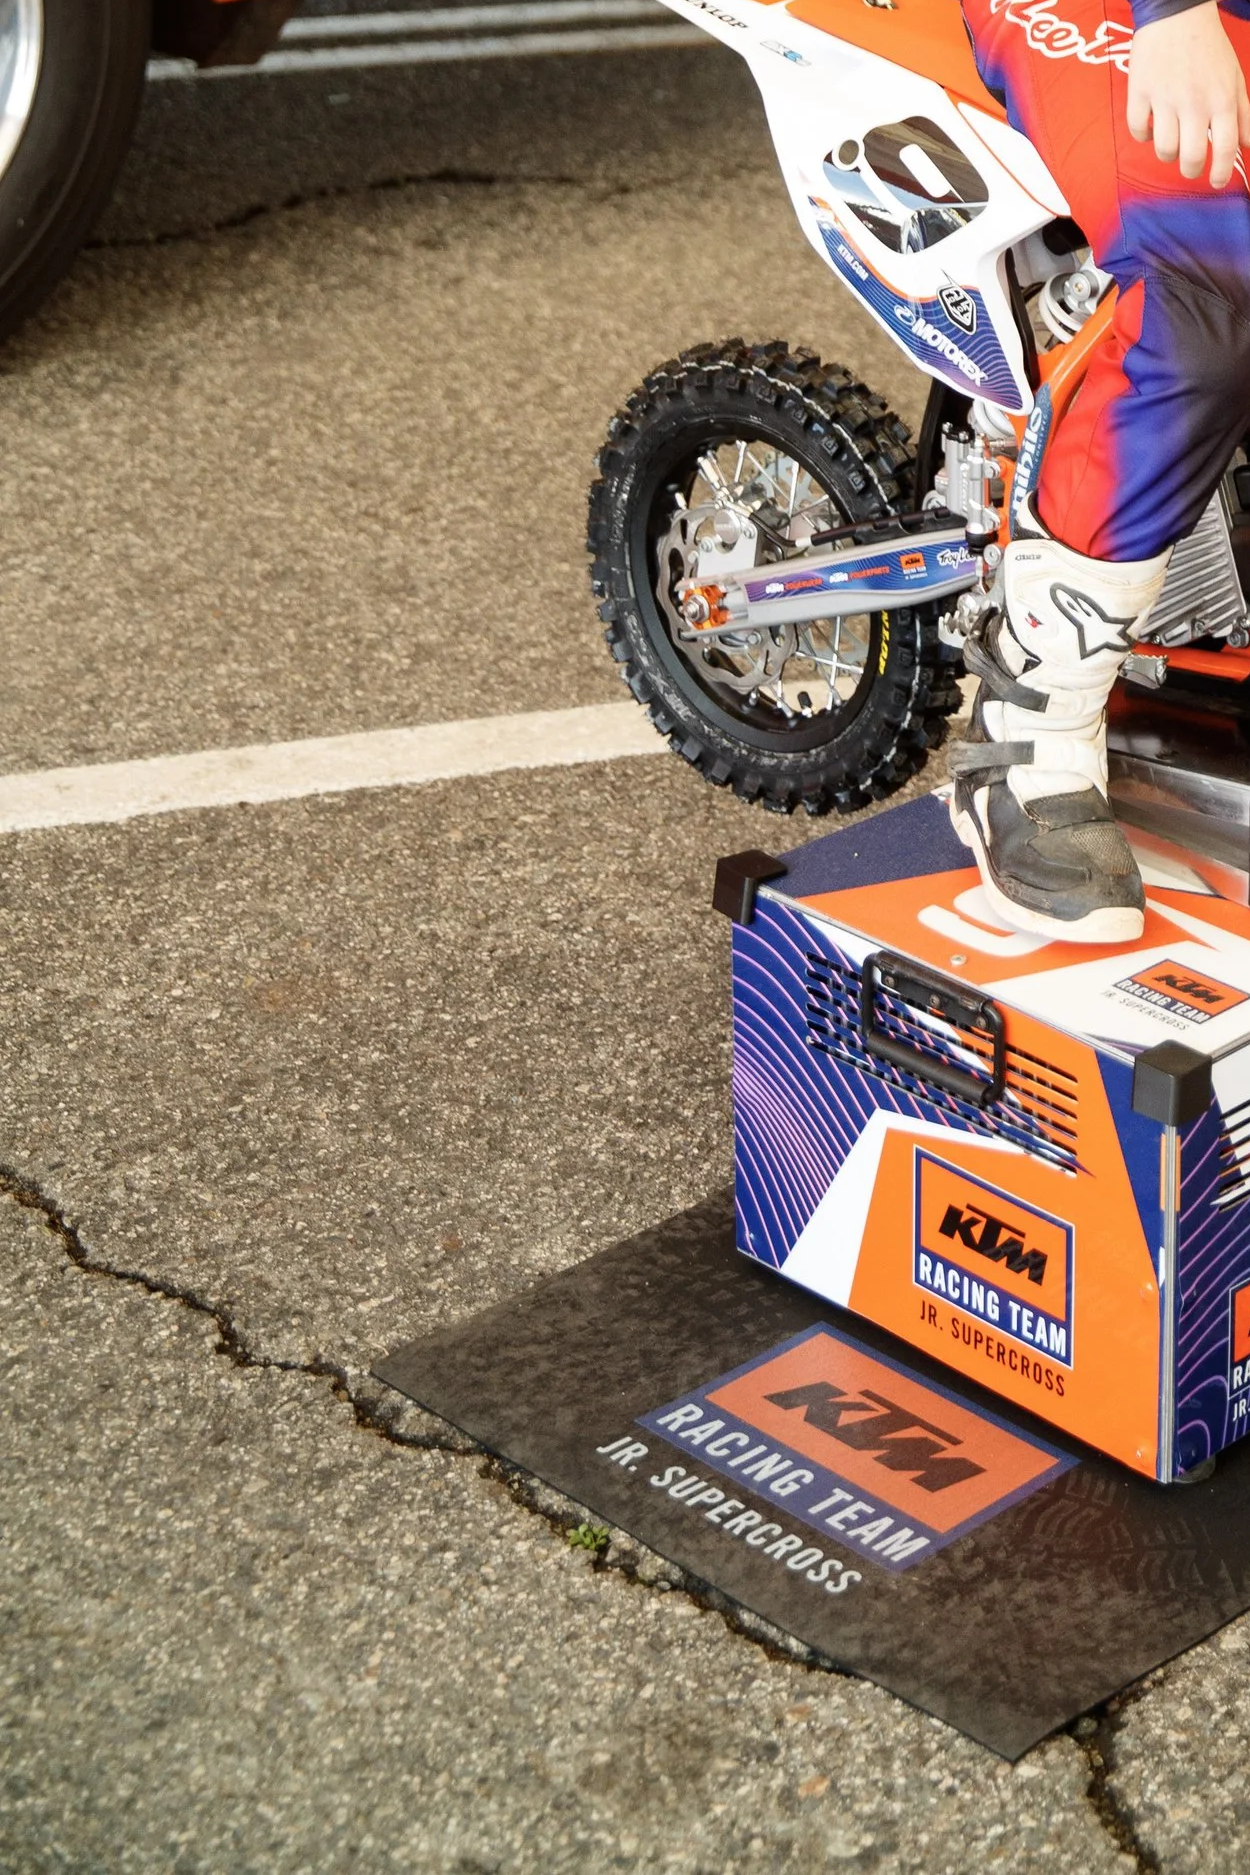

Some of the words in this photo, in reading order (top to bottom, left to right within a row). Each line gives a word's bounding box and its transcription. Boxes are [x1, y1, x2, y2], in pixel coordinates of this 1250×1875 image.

[837, 244, 868, 281] KTM.COM
[911, 318, 989, 387] MOTOREX
[879, 609, 890, 675] NLOP
[1116, 979, 1172, 1006] RACING
[1170, 1001, 1211, 1023] TEAM
[1119, 997, 1190, 1031] SUPERCROSS
[1152, 974, 1226, 1004] KTM
[939, 1202, 1049, 1286] KTM
[917, 1252, 1001, 1323] RACING
[1008, 1303, 1067, 1357] TEAM
[919, 1299, 943, 1331] JR.
[950, 1322, 1066, 1398] SUPERCROSS
[762, 1380, 987, 1493] KTM
[1232, 1397, 1250, 1422] JR.
[596, 1436, 639, 1473] JR.
[650, 1465, 862, 1595] SUPERCROSS
[656, 1402, 815, 1497] RACING
[811, 1491, 930, 1564] TEAM
